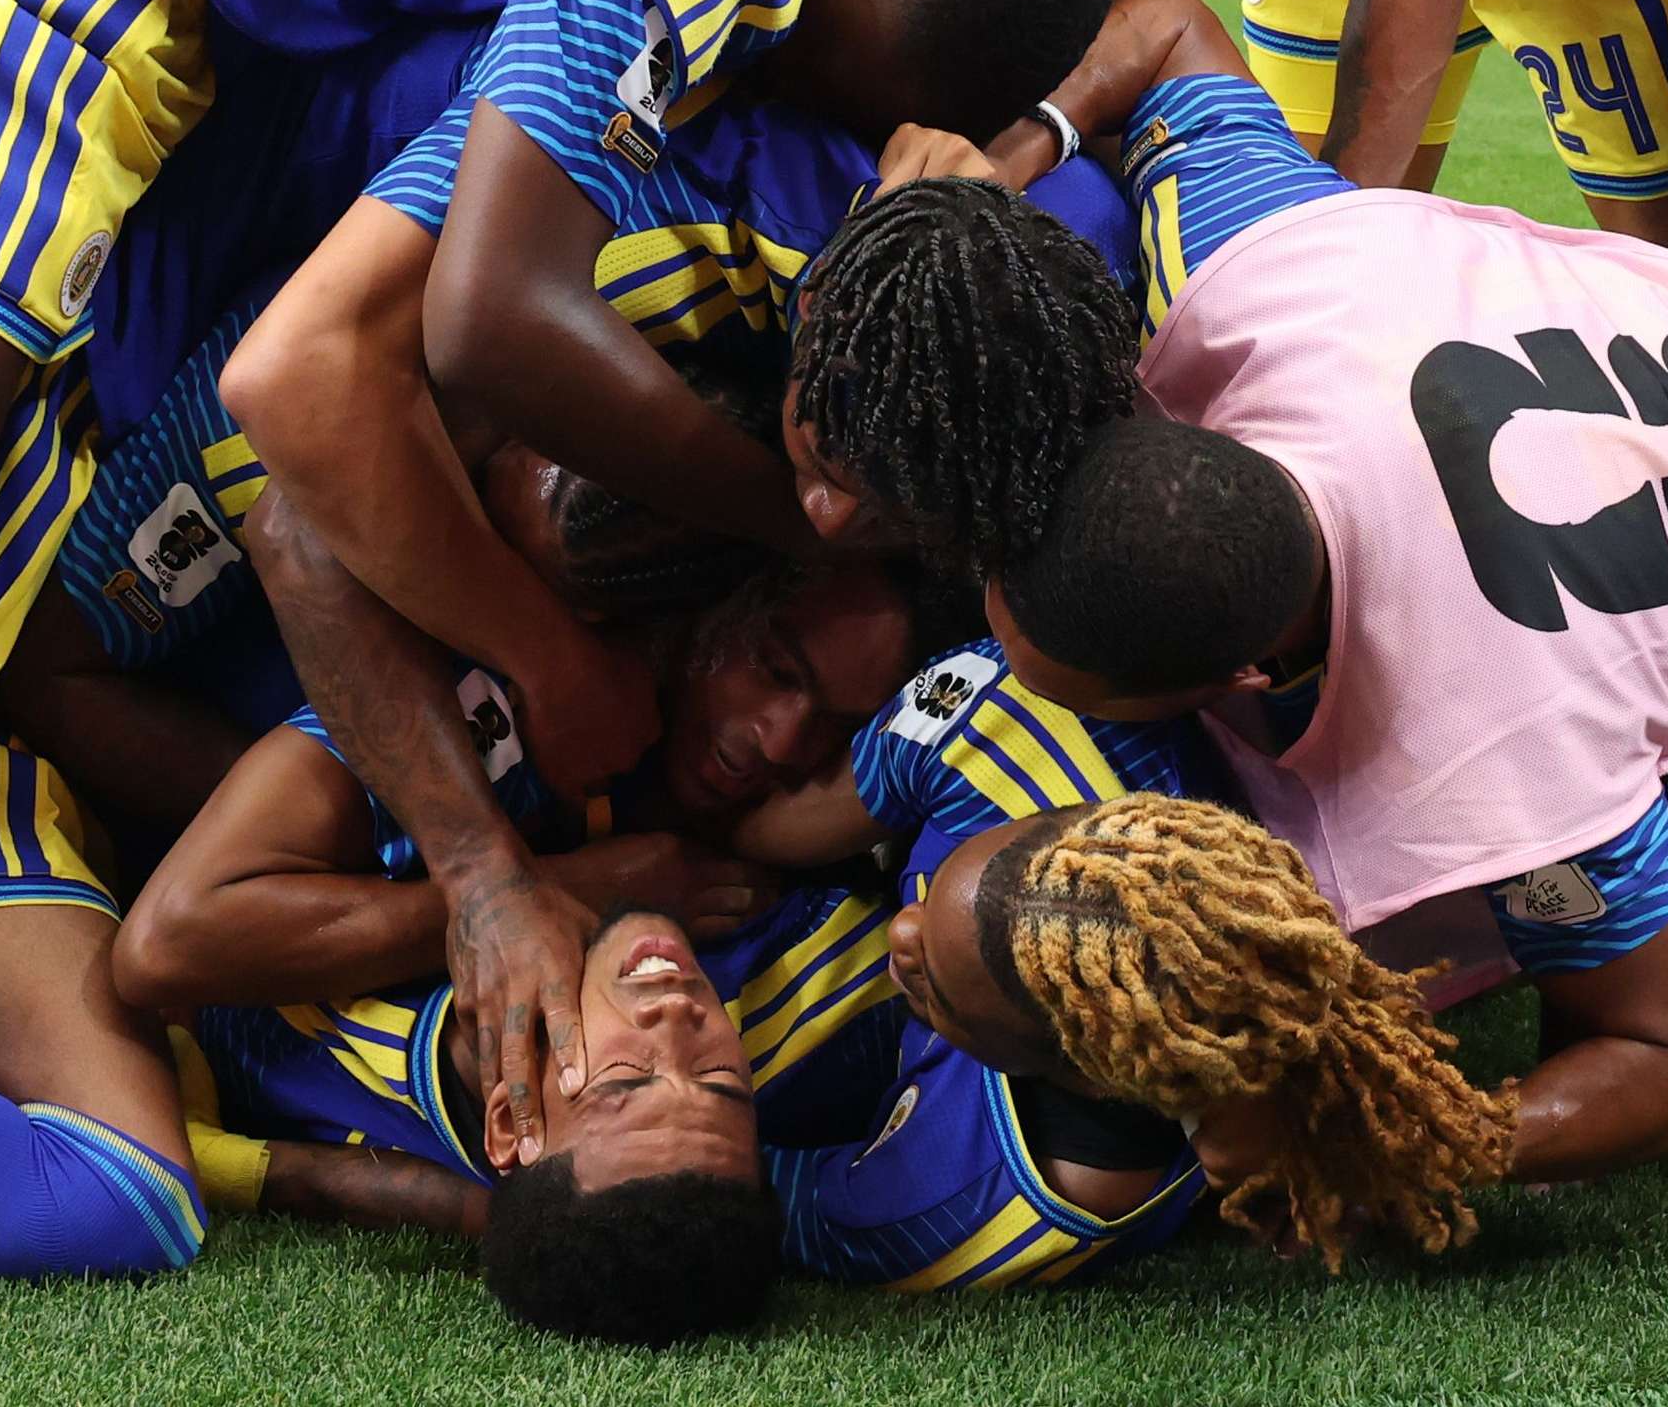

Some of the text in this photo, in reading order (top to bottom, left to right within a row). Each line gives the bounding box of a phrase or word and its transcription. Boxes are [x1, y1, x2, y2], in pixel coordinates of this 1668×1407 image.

[1513, 33, 1660, 156] 24
[621, 133, 654, 164] DEBUT
[1525, 892, 1570, 913] PEACE
